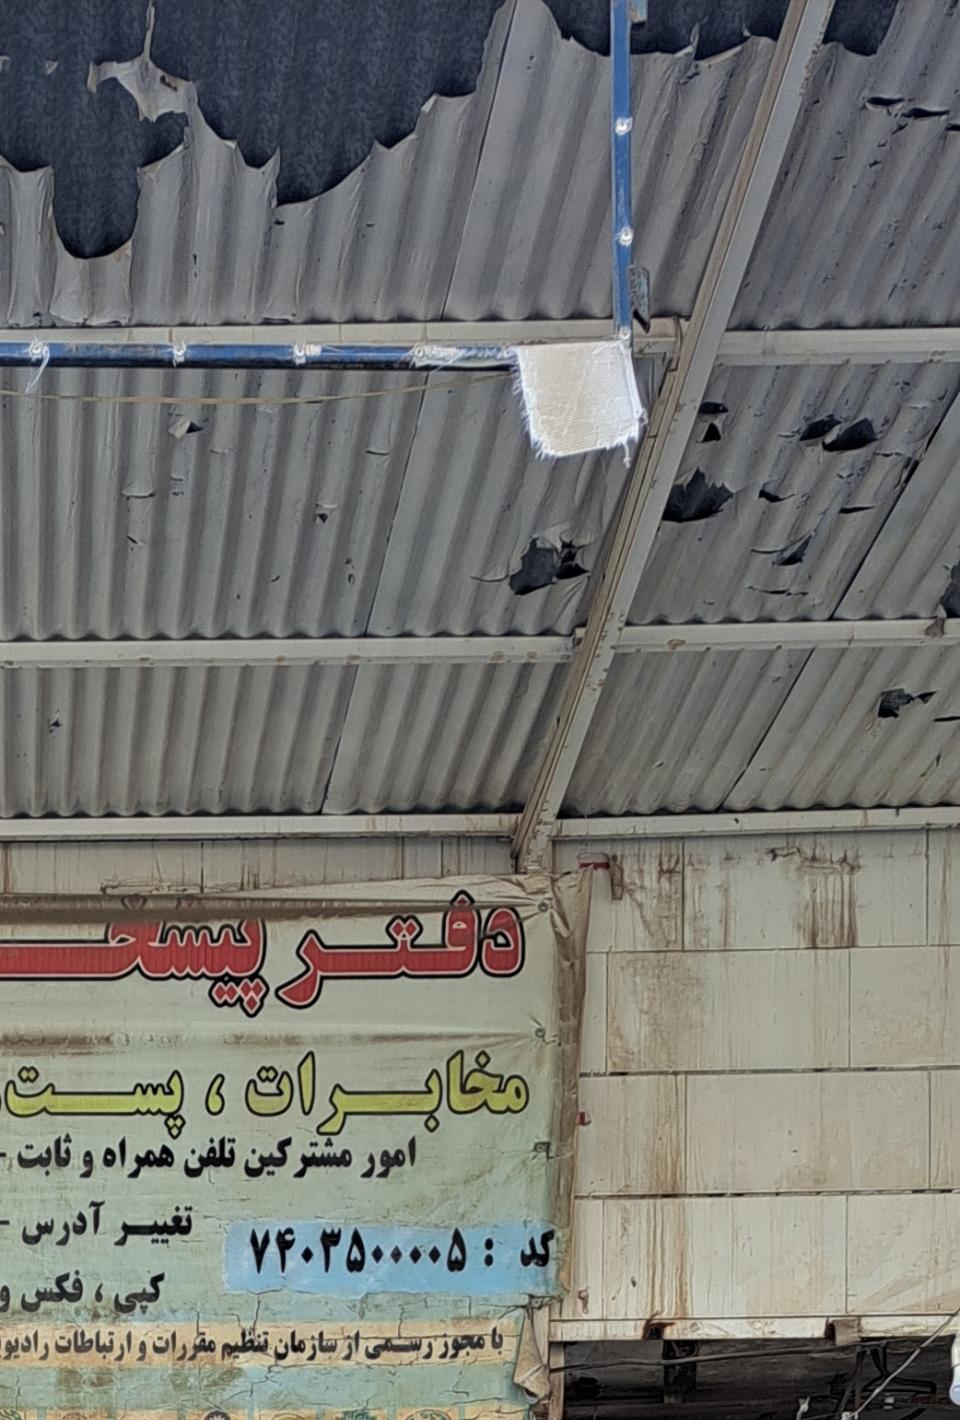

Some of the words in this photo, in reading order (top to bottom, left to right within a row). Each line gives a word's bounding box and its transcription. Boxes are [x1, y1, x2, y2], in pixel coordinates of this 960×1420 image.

[276, 890, 525, 1008] دفتر
[4, 1065, 185, 1139] پست
[245, 1050, 530, 1136] مخابرات
[17, 1136, 72, 1175] ثابت
[82, 1150, 95, 1177] و
[103, 1137, 175, 1178] همراه
[184, 1137, 236, 1175] تلفن
[243, 1137, 353, 1178] مشترکین
[361, 1137, 416, 1177] امور
[21, 1201, 104, 1247] آدرس
[115, 1206, 193, 1245] تغییر
[250, 1227, 467, 1274] ۷۴۰۳۵۰۰۰۰۵
[520, 1228, 555, 1267] کد
[21, 1270, 84, 1305] فکس
[113, 1272, 165, 1314] کپی
[55, 1330, 133, 1361] ارتباطات
[152, 1330, 217, 1361] مقررات
[221, 1328, 270, 1360] تنظیم
[273, 1330, 339, 1361] سازمان
[343, 1329, 362, 1359] از
[364, 1335, 432, 1361] رسمی
[438, 1332, 485, 1360] مجوز
[486, 1327, 504, 1351] با
